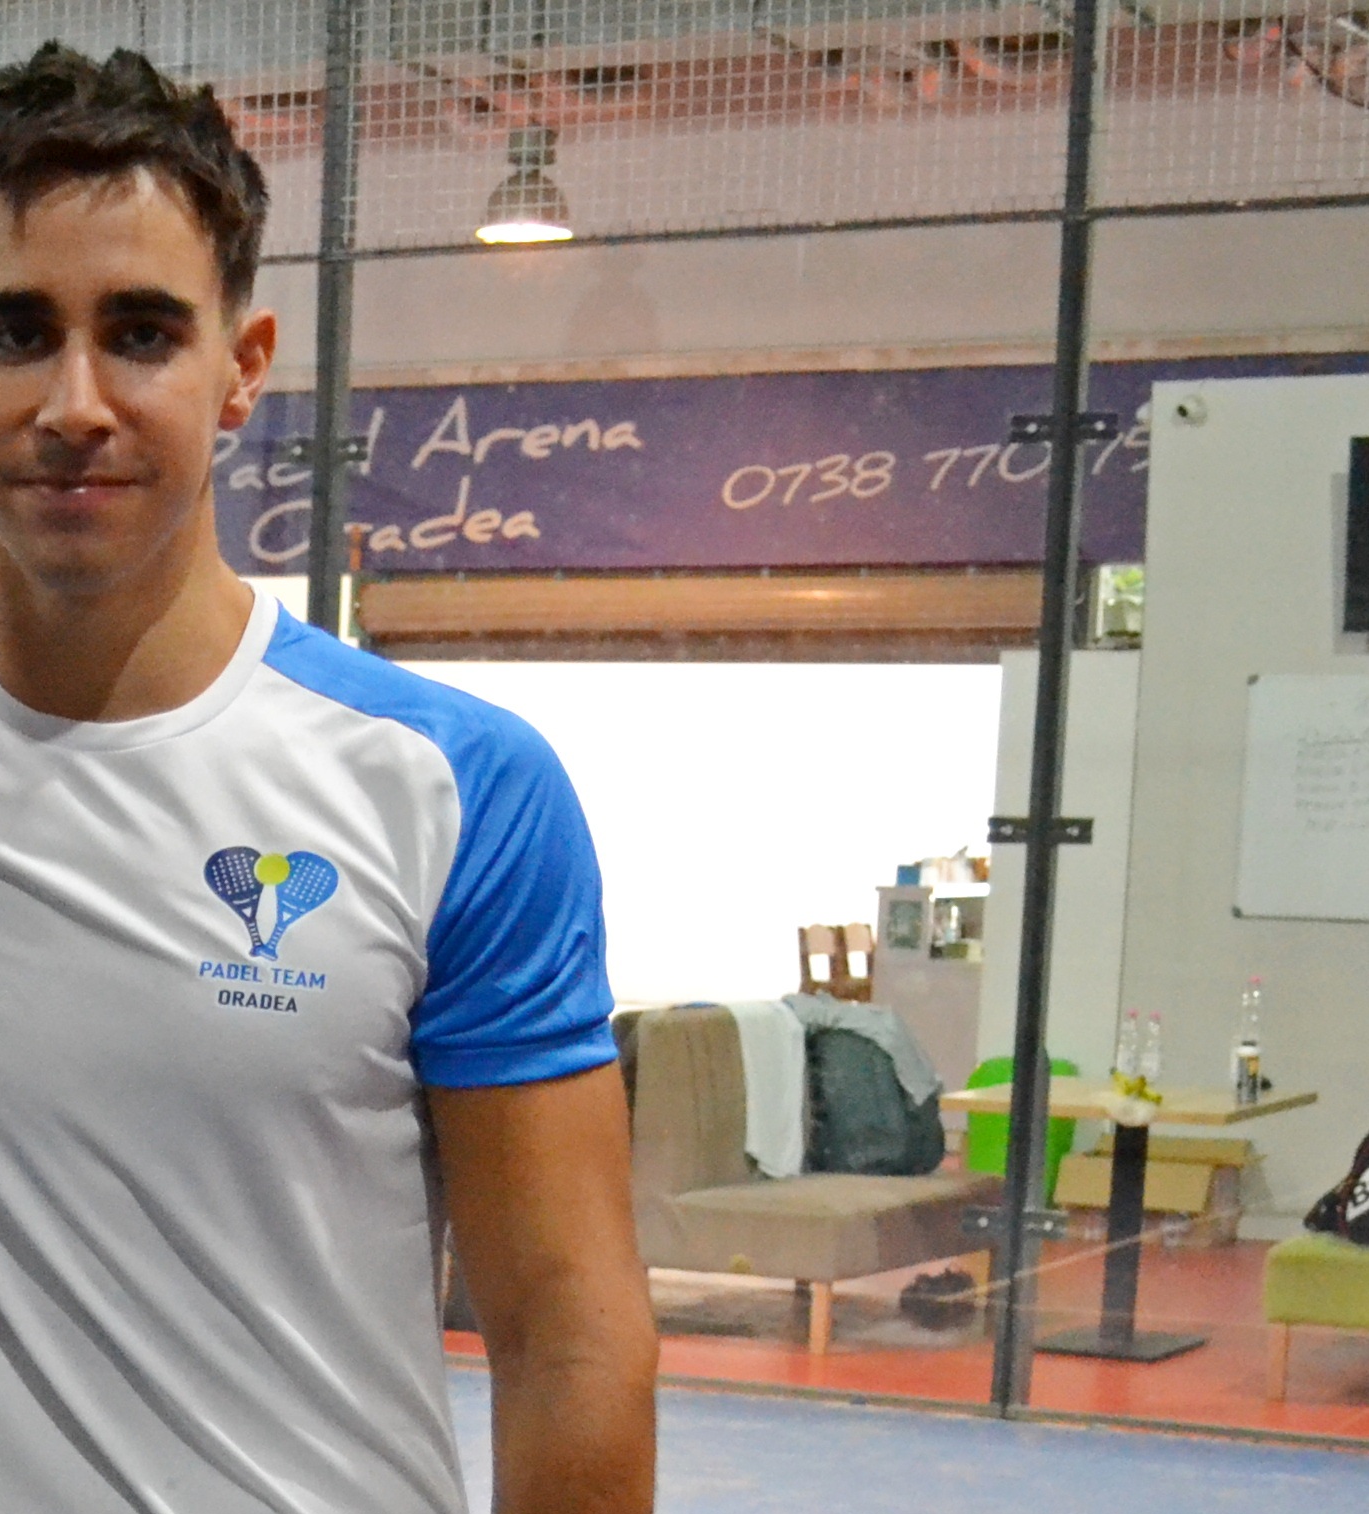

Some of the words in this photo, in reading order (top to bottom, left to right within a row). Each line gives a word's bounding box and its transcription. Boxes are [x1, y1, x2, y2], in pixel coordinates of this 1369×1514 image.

[412, 394, 644, 471] Arena
[721, 449, 896, 510] 0738
[199, 960, 263, 984] PADEL
[271, 967, 327, 990] TEAM
[218, 989, 298, 1013] ORADEA
